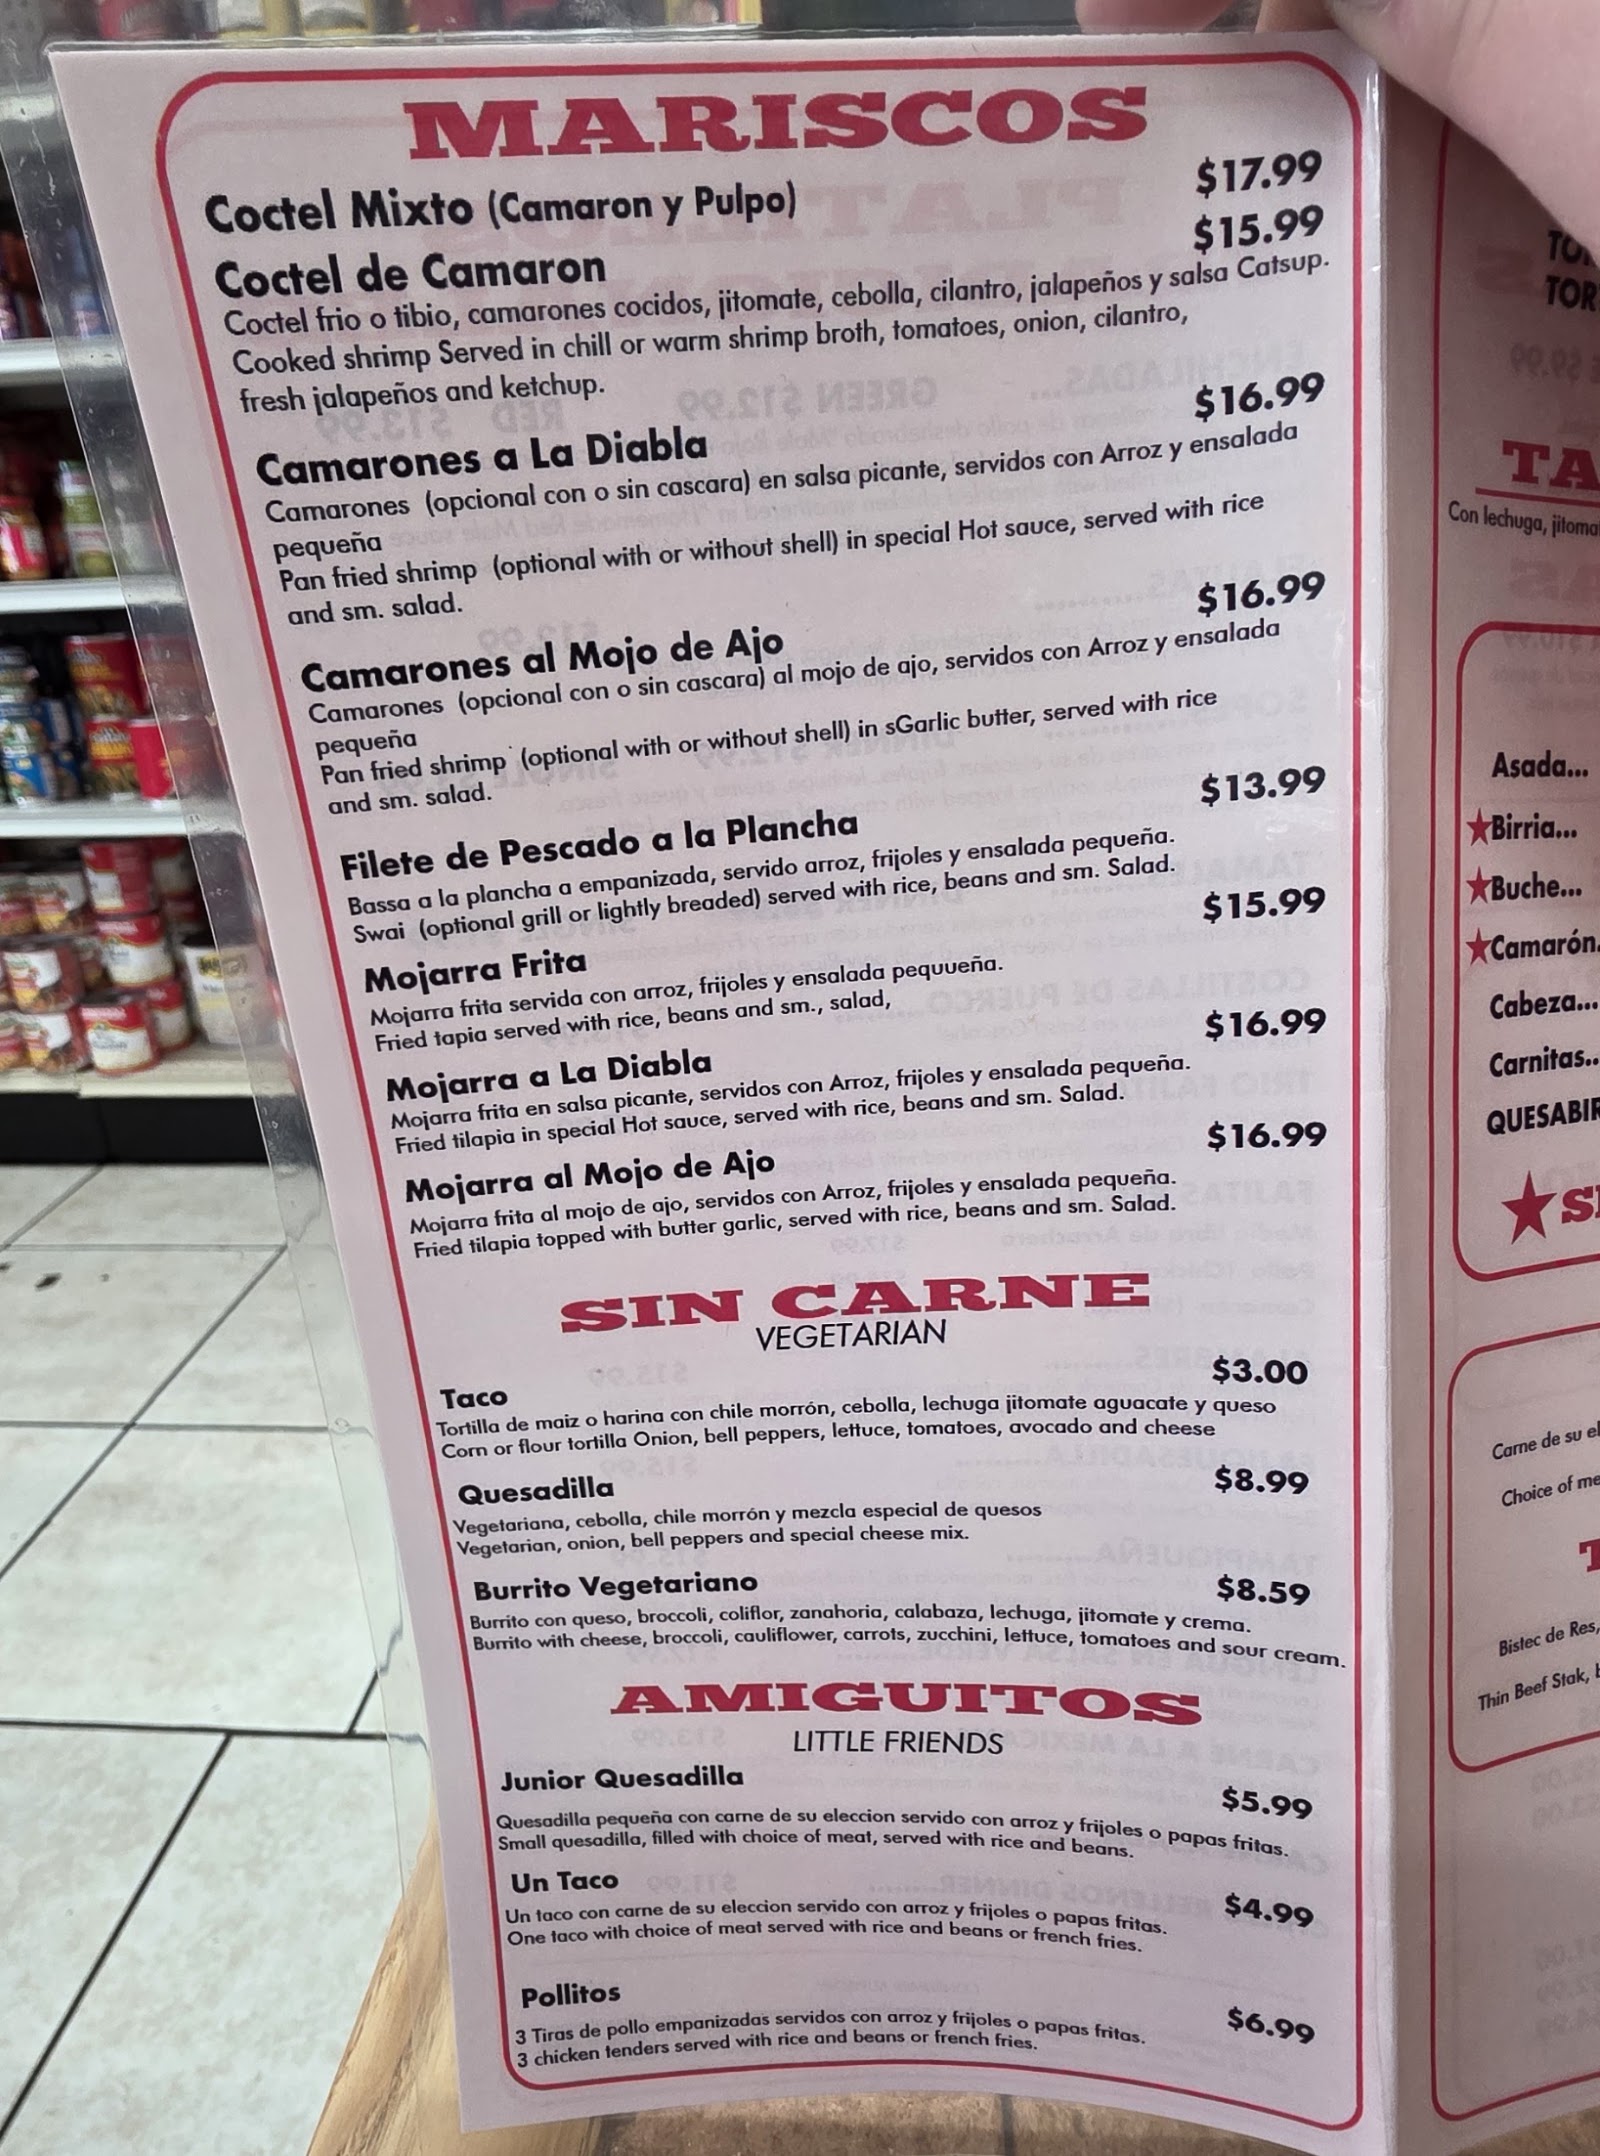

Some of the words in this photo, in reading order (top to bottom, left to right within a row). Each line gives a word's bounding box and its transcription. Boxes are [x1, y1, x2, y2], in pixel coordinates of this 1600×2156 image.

[403, 86, 1145, 160] MARISCOS
[1195, 149, 1323, 200] $17.99
[204, 187, 337, 235] Coctel
[350, 186, 475, 229] Mixto
[488, 188, 654, 231] (Camaron
[661, 195, 684, 227] y
[694, 179, 796, 224] Pulpo)
[1193, 204, 1324, 256] $15.99
[214, 252, 344, 300] Coctel
[356, 251, 409, 293] de
[421, 251, 607, 290] Camaron
[232, 344, 336, 375] Cooked
[343, 343, 432, 374] shrimp
[438, 335, 525, 365] Served
[531, 336, 556, 360] in
[563, 330, 612, 358] chill
[619, 337, 646, 355] or
[652, 334, 721, 353] warm
[728, 324, 809, 353] shrimp
[815, 318, 885, 347] broth,
[892, 316, 1006, 341] tomatoes,
[1013, 309, 1086, 334] onion,
[1093, 303, 1188, 328] cilantro,
[1194, 371, 1326, 424] $16.99
[255, 449, 482, 487] Camarones
[493, 447, 519, 472] a
[529, 436, 575, 470] La
[585, 425, 708, 466] Diabla
[1448, 499, 1479, 525] Con
[1483, 504, 1549, 536] lechuga,
[1551, 514, 1600, 539] jitoma
[287, 600, 336, 626] and
[341, 604, 385, 622] sm.
[391, 590, 463, 618] salad.
[1197, 570, 1326, 619] $16.99
[300, 655, 512, 693] Camarones
[522, 640, 557, 675] al
[569, 635, 658, 675] Mojo
[670, 629, 715, 663] de
[725, 625, 784, 665] Ajo
[1200, 765, 1327, 808] $13.99
[339, 849, 435, 881] Filete
[445, 840, 490, 871] de
[498, 826, 640, 866] Pescado
[651, 832, 674, 852] a
[683, 819, 716, 849] la
[725, 808, 859, 846] Plancha
[1202, 886, 1326, 925] $15.99
[364, 960, 502, 996] Mojarra
[511, 948, 588, 979] Frita
[374, 1029, 429, 1053] Fried
[433, 1026, 488, 1050] tapia
[493, 1016, 562, 1041] served
[566, 1012, 611, 1033] with
[616, 1010, 661, 1030] rice,
[667, 1005, 729, 1025] beans
[734, 997, 774, 1019] and
[780, 1000, 823, 1016] sm.,
[829, 988, 891, 1011] salad,
[1204, 1007, 1327, 1043] $16.99
[386, 1071, 519, 1104] Mojarra
[529, 1069, 550, 1088] a
[559, 1061, 598, 1085] La
[606, 1047, 713, 1081] Diabla
[1207, 1120, 1328, 1153] $16.99
[405, 1173, 534, 1206] Mojarra
[543, 1162, 574, 1190] al
[584, 1157, 664, 1190] Mojo
[673, 1152, 713, 1179] de
[722, 1148, 776, 1181] Ajo
[560, 1289, 742, 1333] SIN
[772, 1272, 1149, 1320] CARNE
[755, 1318, 947, 1352] VEGETARIAN
[1211, 1354, 1309, 1386] $3.00
[439, 1388, 509, 1410] Taco
[441, 1443, 489, 1459] Corn
[493, 1444, 514, 1456] or
[517, 1438, 563, 1455] flour
[567, 1432, 628, 1451] tortilla
[633, 1430, 699, 1448] Onion,
[703, 1425, 739, 1444] bell
[744, 1427, 826, 1446] peppers,
[831, 1421, 901, 1440] lettuce,
[906, 1420, 1003, 1438] tomatoes,
[1008, 1416, 1093, 1434] avocado
[1098, 1417, 1138, 1435] and
[1143, 1417, 1216, 1437] cheese
[1492, 1439, 1538, 1461] Carne
[1541, 1430, 1561, 1449] de
[1564, 1429, 1583, 1444] su
[457, 1475, 615, 1506] Quesadilla
[1214, 1463, 1310, 1495] $8.99
[1501, 1484, 1553, 1507] Choice
[1557, 1474, 1574, 1494] of
[455, 1538, 562, 1559] Vegetarian,
[566, 1535, 626, 1552] onion,
[630, 1531, 665, 1548] bell
[669, 1533, 744, 1551] peppers
[749, 1526, 785, 1544] and
[789, 1524, 854, 1547] special
[859, 1524, 925, 1541] cheese
[930, 1524, 970, 1540] mix.
[473, 1577, 571, 1602] Burrito
[577, 1570, 759, 1602] Vegetariano
[1216, 1573, 1311, 1607] $8.59
[472, 1635, 533, 1651] Burrito
[536, 1632, 575, 1649] with
[579, 1631, 648, 1649] cheese,
[652, 1628, 729, 1646] broccoli,
[734, 1626, 838, 1645] cauliflower,
[843, 1627, 912, 1644] carrots,
[916, 1625, 998, 1645] zucchini,
[1004, 1626, 1074, 1648] lettuce,
[1079, 1630, 1172, 1650] tomatoes
[1177, 1636, 1216, 1654] and
[1222, 1644, 1268, 1658] sour
[1273, 1649, 1346, 1669] cream.
[1498, 1635, 1542, 1658] Bistec
[1544, 1625, 1565, 1644] de
[614, 1681, 1201, 1725] AMIGUITOS
[1477, 1690, 1510, 1712] Thin
[1514, 1675, 1549, 1701] Beef
[1551, 1667, 1590, 1689] Stak,
[793, 1730, 875, 1753] LITTLE
[884, 1730, 1004, 1755] FRIENDS
[500, 1768, 586, 1792] Junior
[594, 1764, 745, 1789] Quesadilla
[1221, 1785, 1313, 1820] $5.99
[510, 1872, 550, 1894] Un
[556, 1870, 619, 1891] Taco
[1224, 1891, 1315, 1929] $4.99
[521, 1982, 621, 2009] Pollitos
[1227, 2005, 1316, 2045] $6.99
[517, 2052, 529, 2069] 3
[534, 2046, 600, 2067] chicken
[604, 2040, 670, 2059] tenders
[674, 2033, 731, 2053] served
[735, 2031, 773, 2048] with
[777, 2031, 809, 2046] rice
[814, 2028, 848, 2045] and
[852, 2028, 906, 2044] beans
[910, 2033, 930, 2044] or
[934, 2029, 990, 2046] french
[994, 2032, 1038, 2051] fries.
